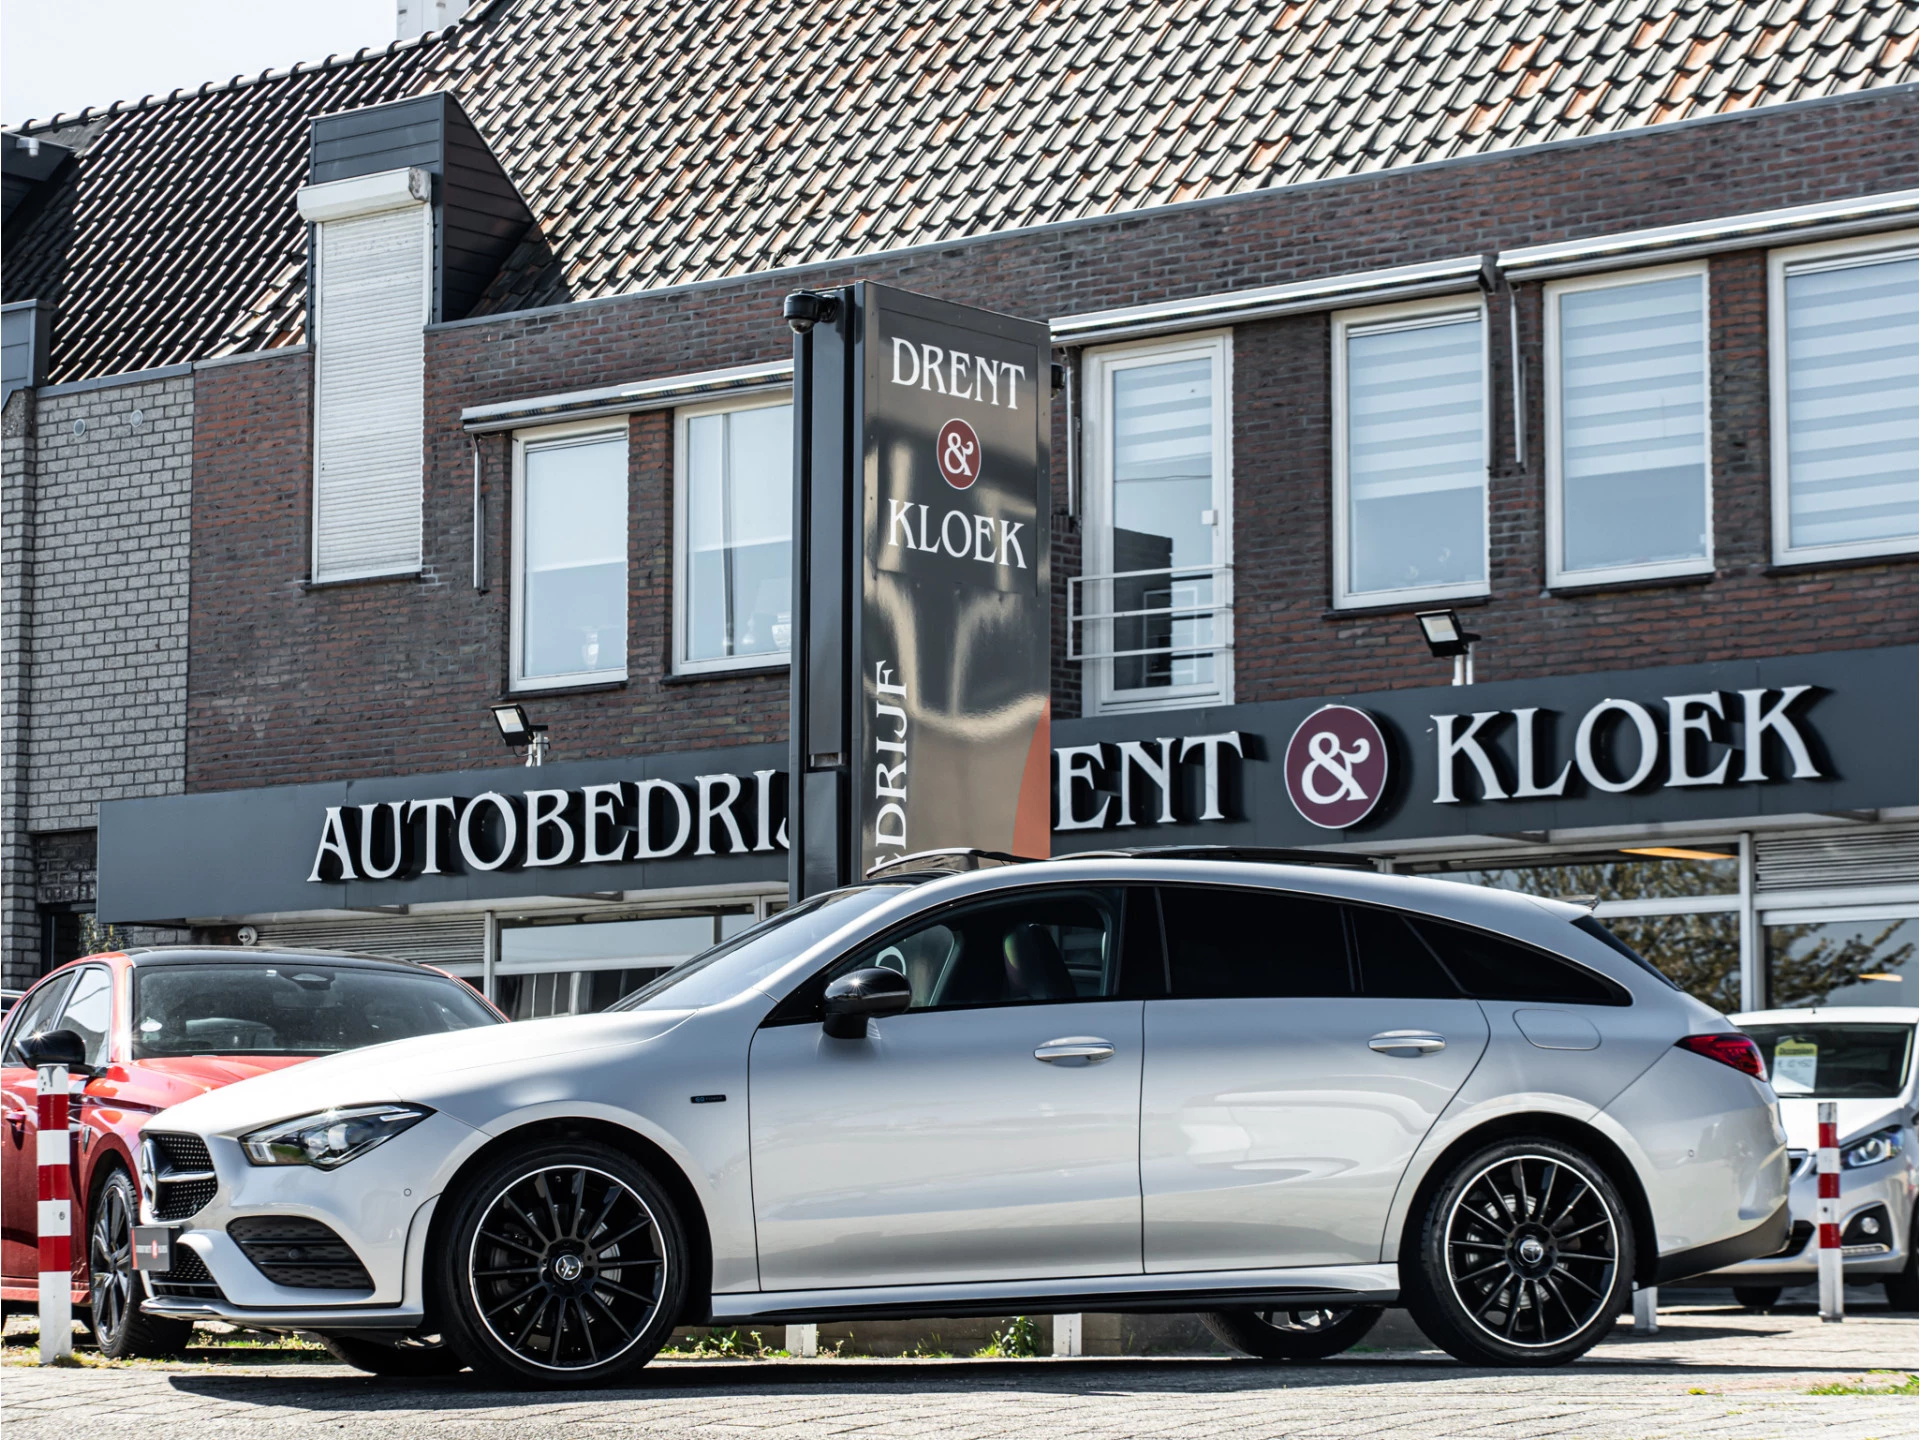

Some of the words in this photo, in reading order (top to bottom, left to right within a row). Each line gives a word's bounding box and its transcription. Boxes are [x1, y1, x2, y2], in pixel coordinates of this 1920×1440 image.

[890, 336, 1025, 411] DRENT
[943, 432, 974, 477] &
[888, 498, 1027, 569] KLOEK
[875, 659, 908, 866] DRIJF
[1053, 731, 1244, 831] ENT
[1300, 731, 1371, 804] &
[1430, 685, 1823, 804] KLOEK
